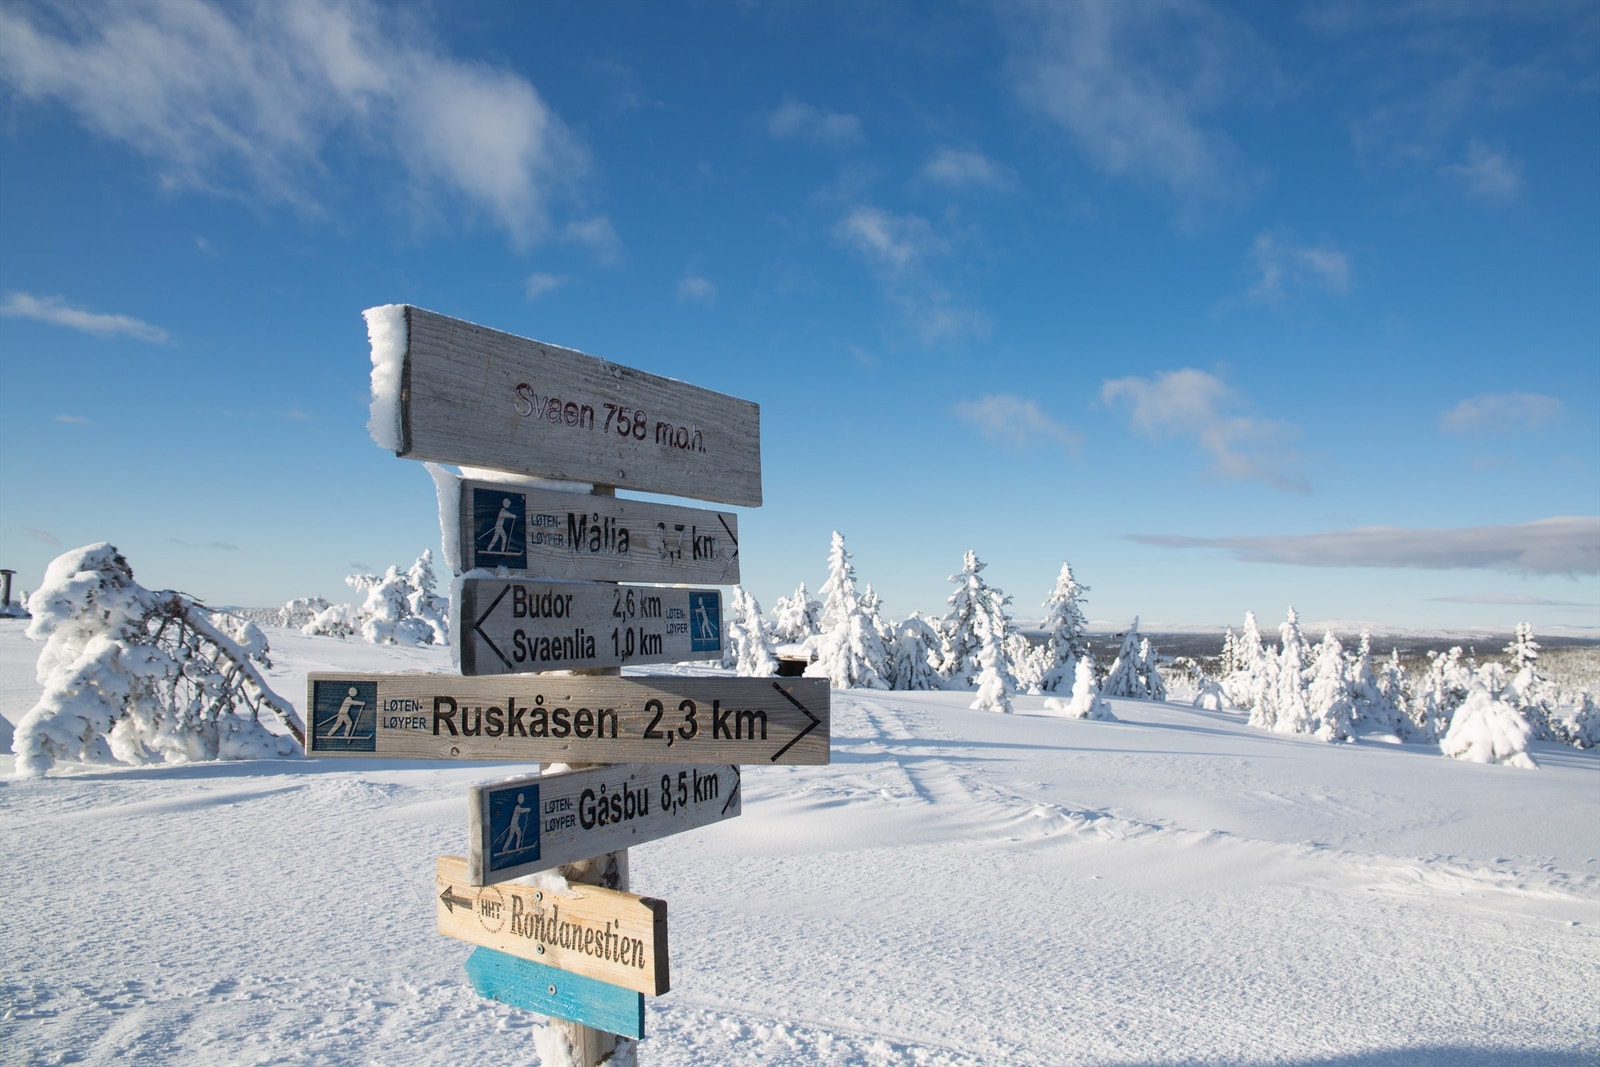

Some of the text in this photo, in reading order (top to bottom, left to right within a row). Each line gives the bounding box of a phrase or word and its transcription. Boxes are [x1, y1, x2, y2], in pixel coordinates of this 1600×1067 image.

[513, 382, 594, 431] Svaen
[603, 402, 647, 441] 758
[531, 513, 560, 528] LØTEN-
[531, 531, 564, 546] LØYPER
[568, 512, 630, 554] Målia
[692, 525, 720, 560] km
[512, 585, 662, 623] Budor 2,6 km
[666, 608, 686, 620] LØTEN-
[666, 622, 688, 634] LØYPER
[512, 627, 662, 663] Svaenlia 1,0 km
[383, 699, 423, 712] LØTEN-
[383, 716, 427, 729] LØYPER
[433, 695, 768, 747] Ruskåsen 2,3 km
[544, 797, 573, 814] LØTEN-
[578, 768, 719, 830] Gåsbu 8,5 km
[544, 815, 576, 832] LØYPER
[510, 894, 646, 969] Rondanestien
